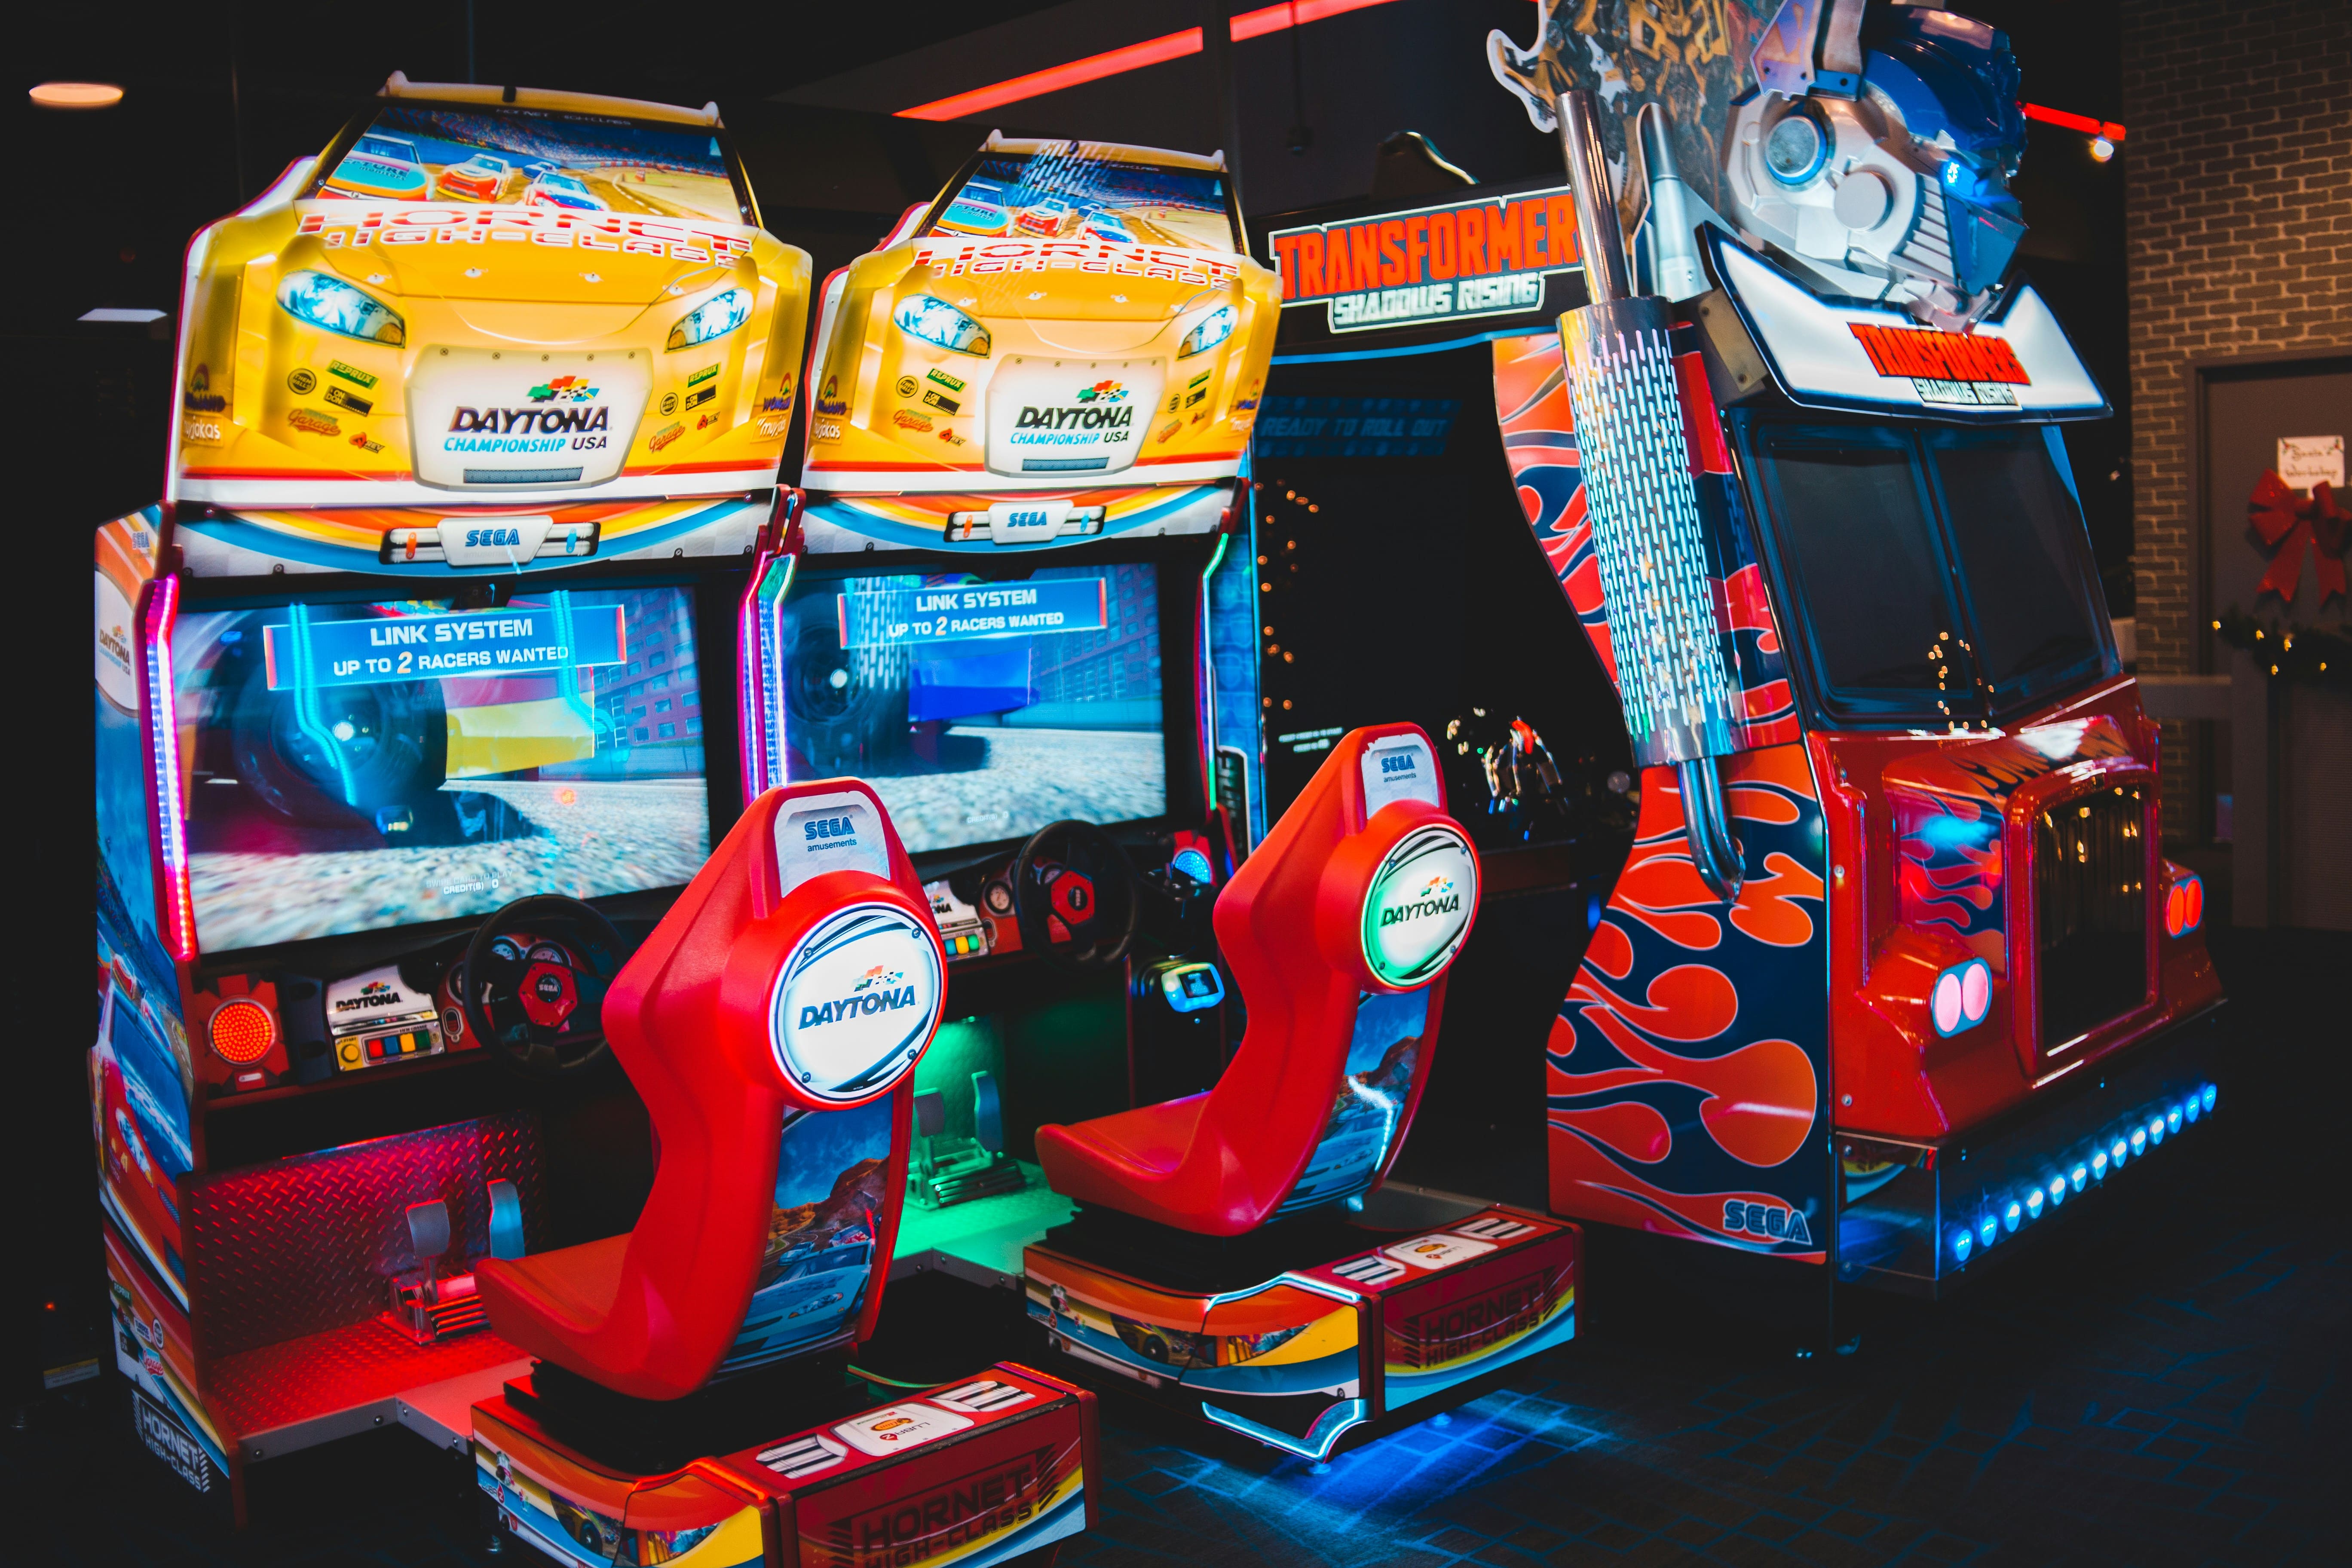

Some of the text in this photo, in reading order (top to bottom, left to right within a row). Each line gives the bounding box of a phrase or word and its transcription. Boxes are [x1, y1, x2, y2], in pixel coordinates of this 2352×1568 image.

[296, 209, 753, 252] HORNET
[912, 242, 1240, 277] HORNET
[1274, 191, 1583, 300] TRANSFORMER
[1333, 273, 1540, 325] SHADOWS RISING
[1848, 323, 2031, 386] TRANSFORMERS
[288, 409, 342, 437] Garage
[447, 406, 609, 435] DAYTONA
[893, 409, 934, 432] Garage
[1015, 405, 1133, 430] DAYTONA
[444, 435, 607, 453] CHAMPIONSHIP USA
[649, 426, 686, 453] Garage
[1010, 431, 1130, 445] CHAMPIONSHIP USA
[1007, 511, 1047, 528] SEGA
[465, 528, 520, 547] SEGA
[916, 588, 1037, 612] LINK SYSTEM
[370, 618, 533, 647] LINK SYSTEM
[888, 612, 1064, 637] UP TO 2 RACERS WANTED
[100, 628, 131, 665] DAYTONA
[334, 646, 569, 676] UP TO 2 RACERS WANTED
[1381, 754, 1415, 773] SEGA
[1383, 772, 1417, 783] amusements
[804, 816, 856, 841] SEGA
[807, 838, 858, 852] amusements
[443, 879, 499, 895] CREDIT(S) 0
[1380, 893, 1460, 928] DAYTONA
[336, 992, 401, 1011] DAYTONA
[798, 985, 916, 1030] DAYTONA
[1723, 1198, 1813, 1246] SEGA
[1424, 1280, 1540, 1347] HORNET
[1426, 1313, 1540, 1368] HIGH-CLASS
[143, 1349, 164, 1376] Garage
[142, 1405, 199, 1471] HORNET
[144, 1433, 202, 1492] HIGH-CLASS
[861, 1464, 1032, 1556] HORNET
[863, 1503, 1035, 1568] HIGH-CLASS
